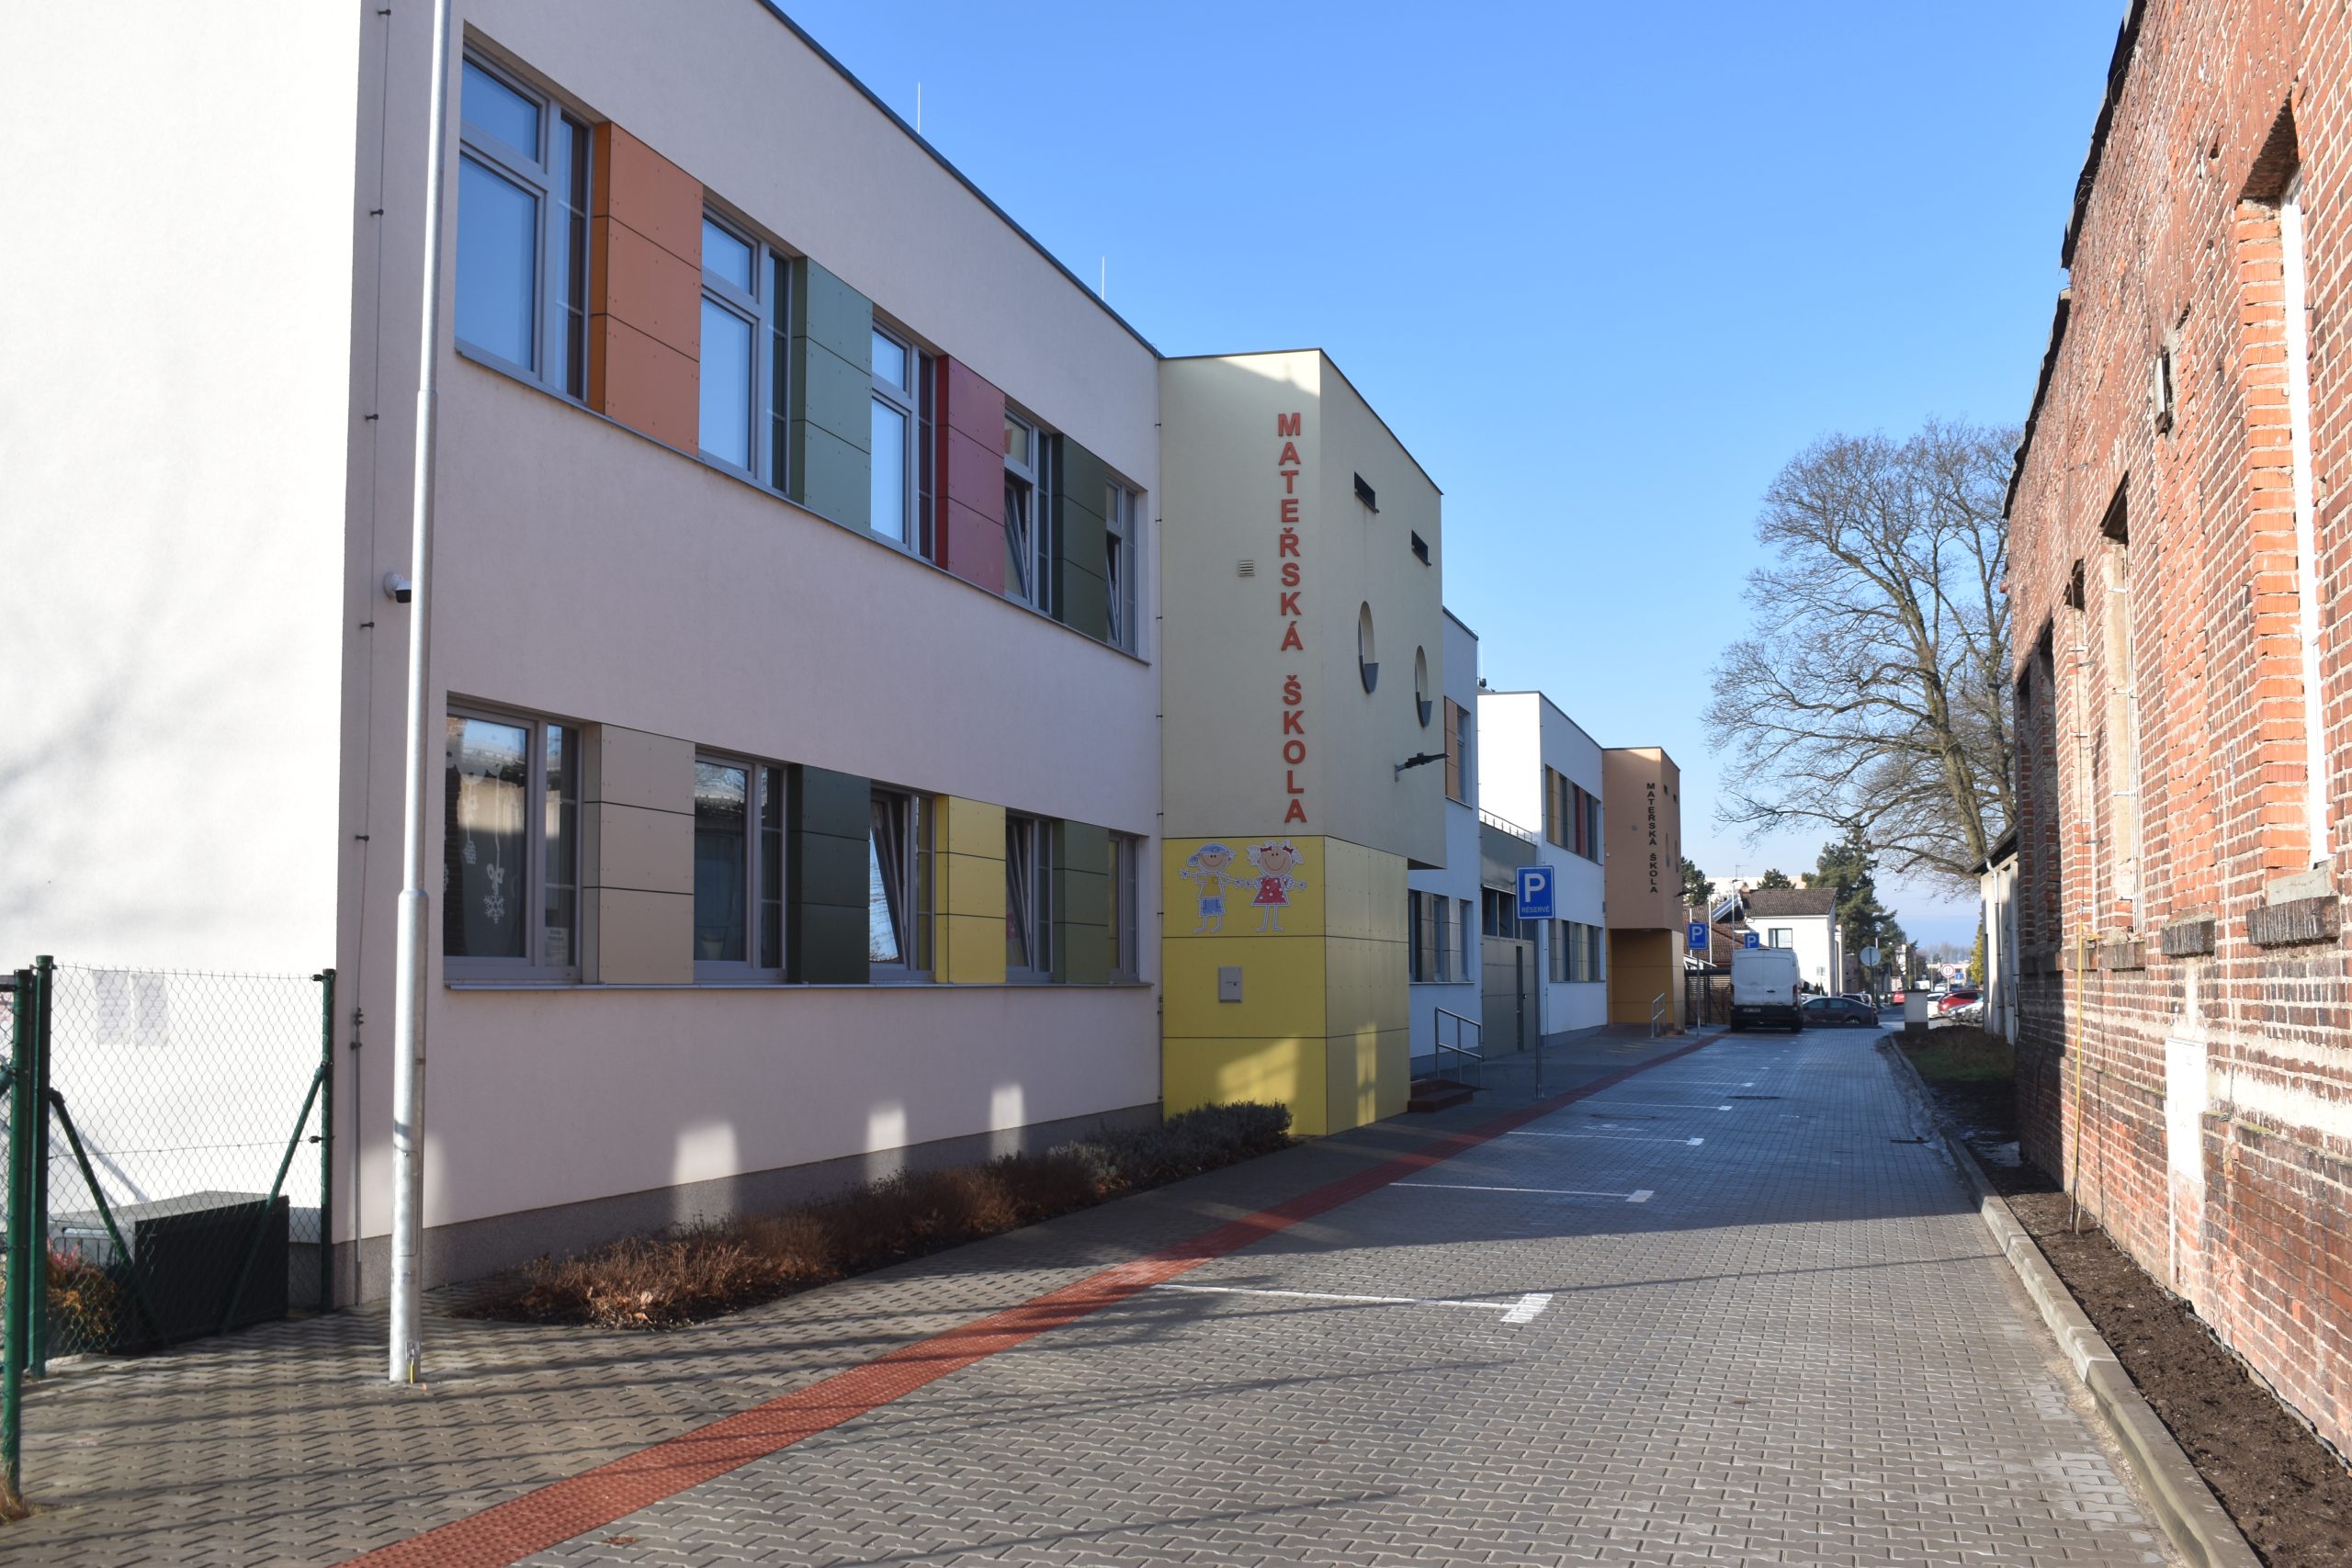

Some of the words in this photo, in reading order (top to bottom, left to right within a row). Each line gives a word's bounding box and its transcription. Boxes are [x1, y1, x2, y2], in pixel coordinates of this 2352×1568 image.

[1277, 412, 1304, 651] MATEŘSKÁ
[1282, 674, 1307, 824] ŠKOLA
[1524, 873, 1545, 903] P
[1649, 852, 1658, 894] ŠKOLA
[1691, 926, 1703, 942] P
[1747, 935, 1757, 947] P
